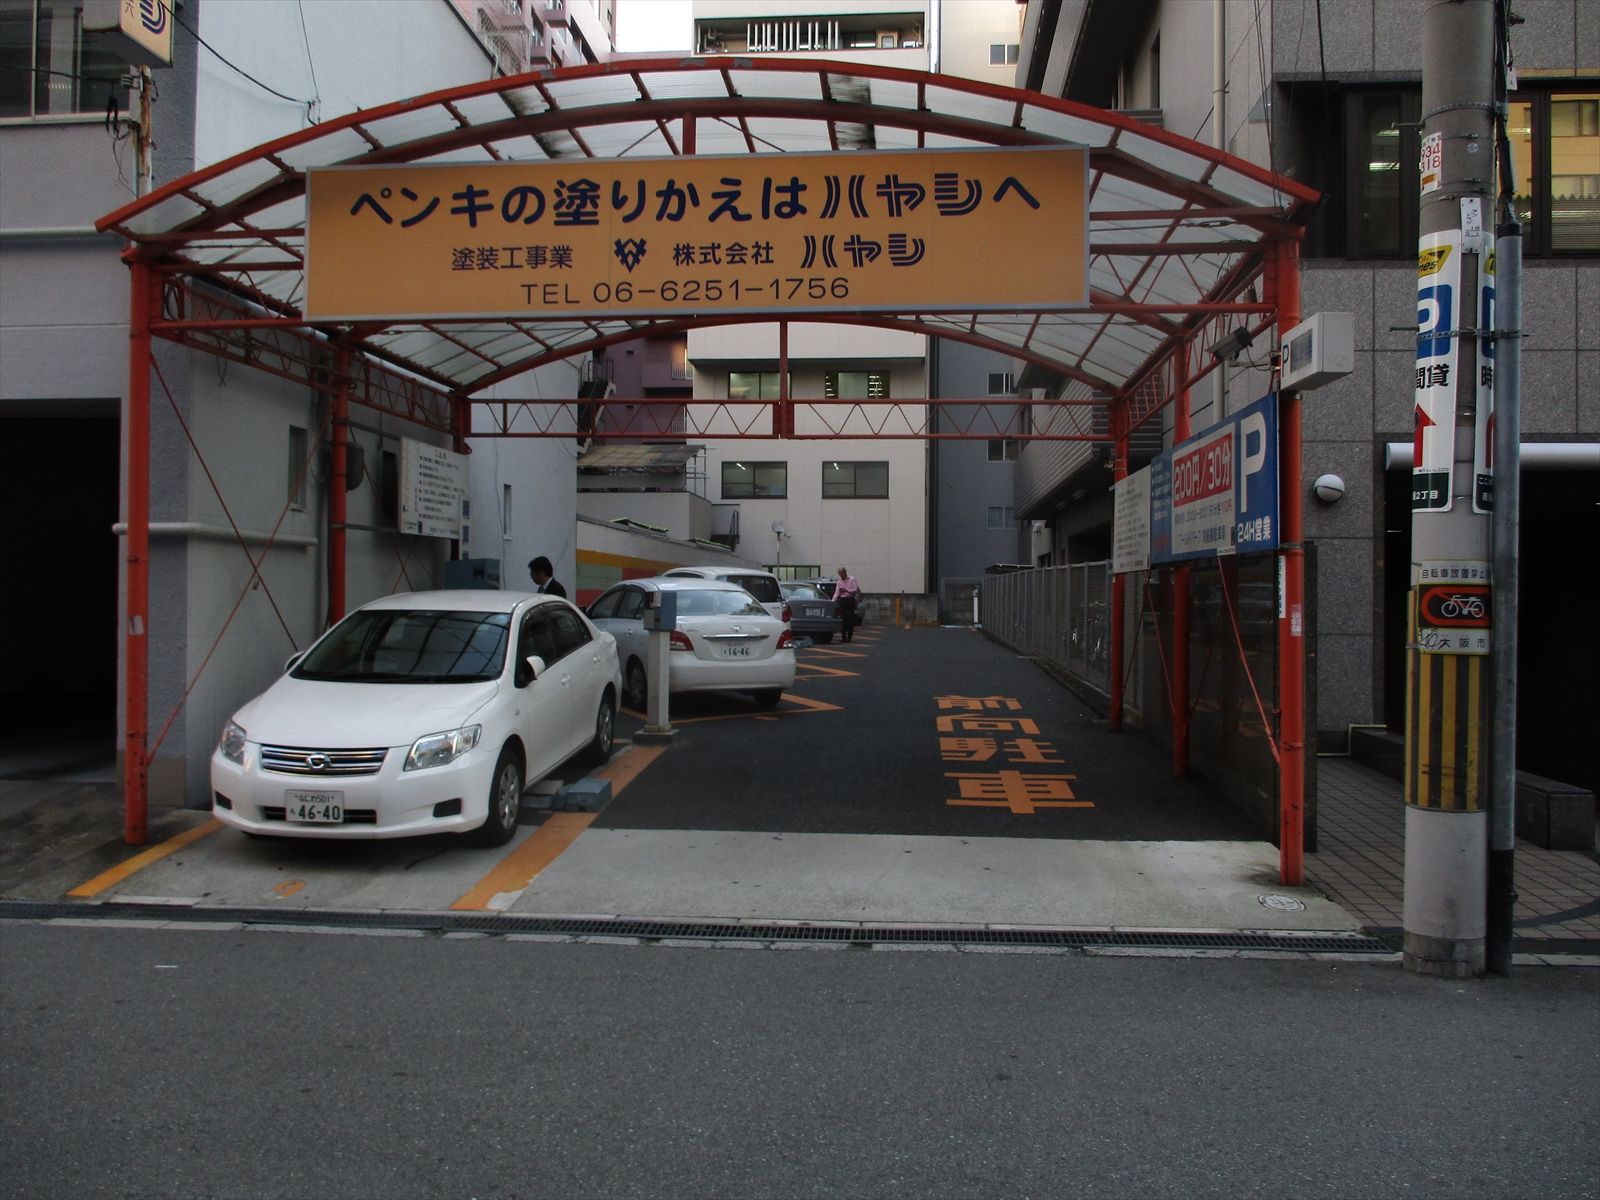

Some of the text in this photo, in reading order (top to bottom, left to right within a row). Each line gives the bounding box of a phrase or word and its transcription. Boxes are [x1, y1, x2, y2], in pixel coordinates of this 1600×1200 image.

[350, 172, 1040, 228] ペンキの塗りかえはハヤシへ
[452, 233, 926, 271] 塗装工事業 株式会社 ハヤシ
[521, 277, 850, 304] TEL 06-6251-1756
[1240, 411, 1267, 513] P
[298, 804, 340, 820] 46-40
